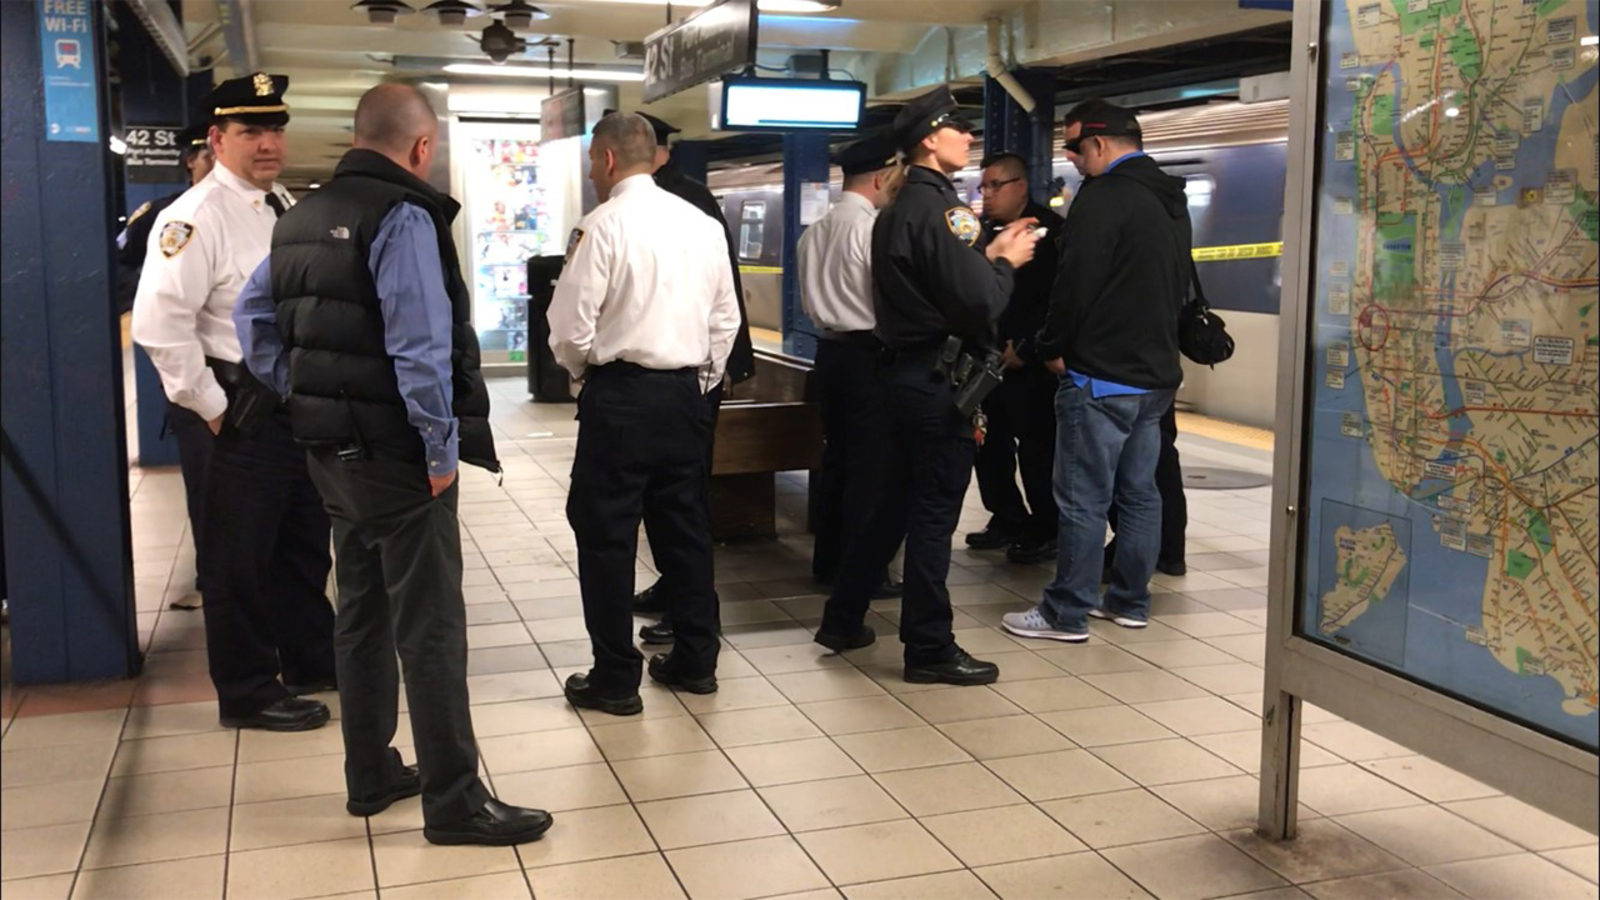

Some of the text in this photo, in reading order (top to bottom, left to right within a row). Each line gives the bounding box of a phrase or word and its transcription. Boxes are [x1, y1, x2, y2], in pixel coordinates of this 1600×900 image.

[43, 0, 87, 15] FREE
[126, 129, 177, 146] 42 St
